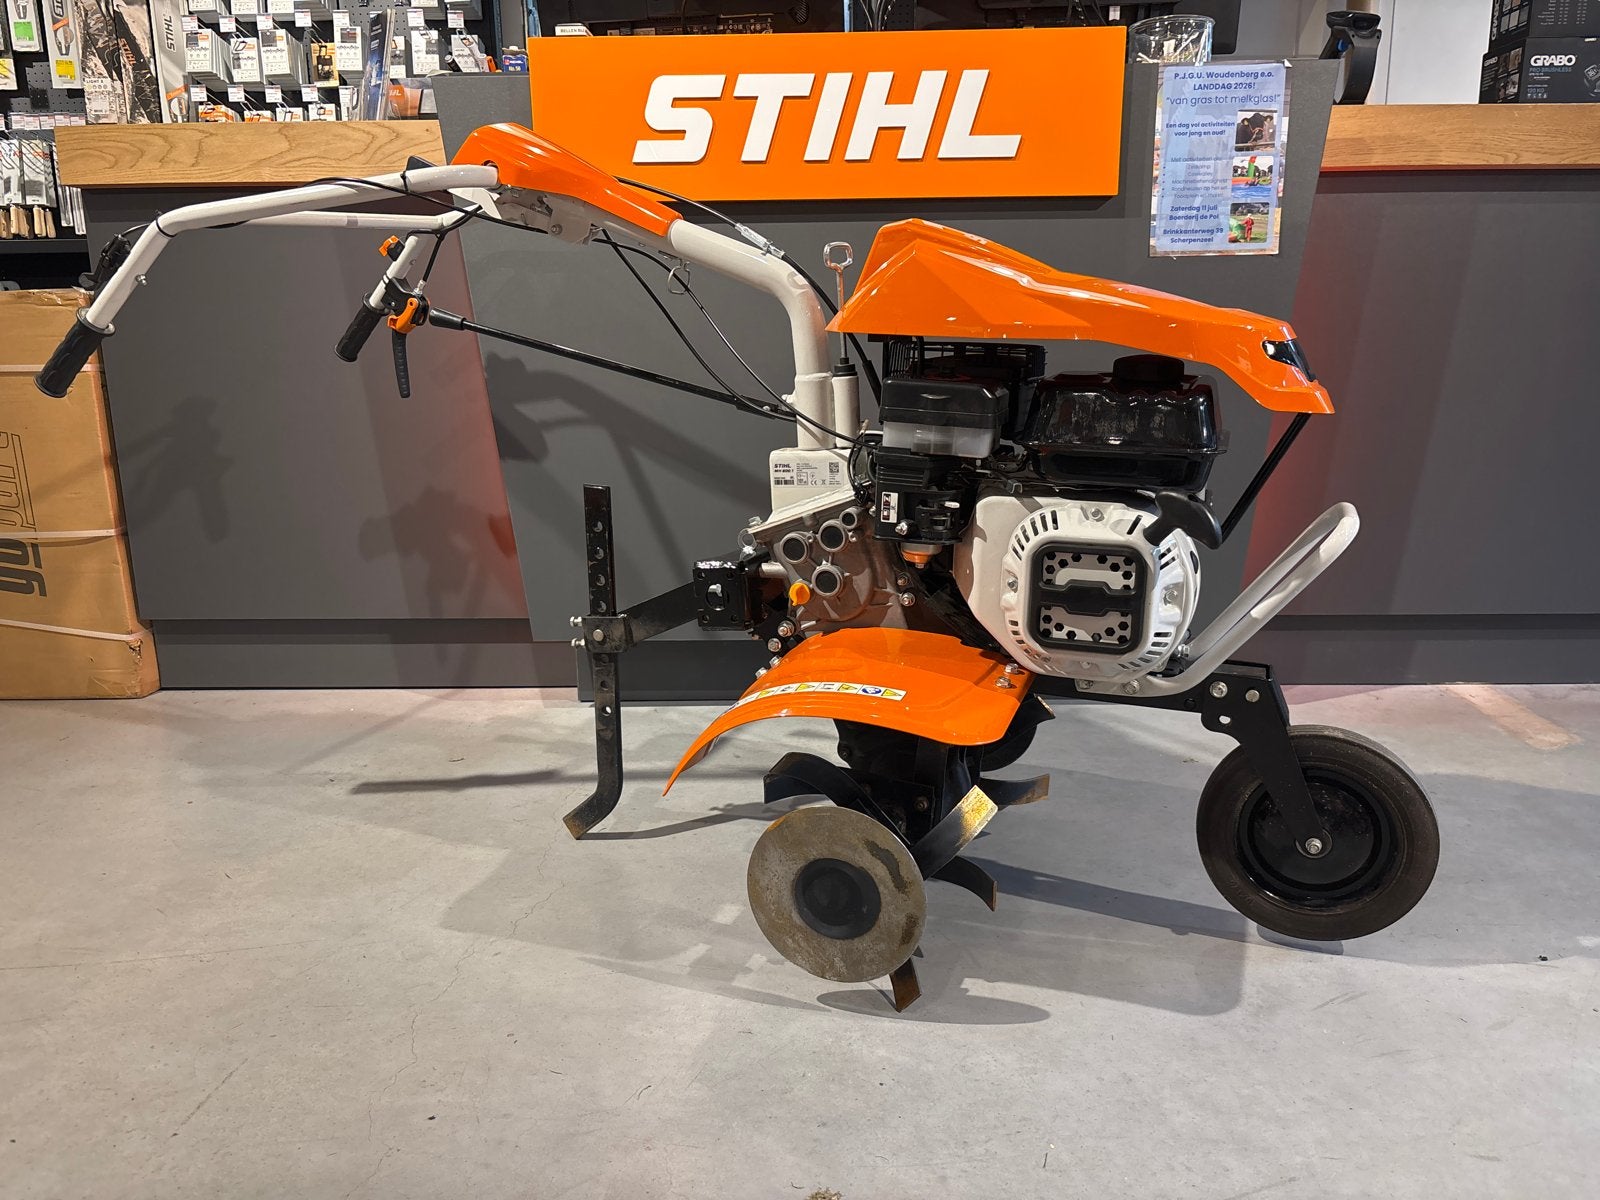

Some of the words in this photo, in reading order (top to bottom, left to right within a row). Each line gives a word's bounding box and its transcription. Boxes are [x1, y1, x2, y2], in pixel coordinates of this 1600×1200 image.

[164, 15, 176, 51] STIHL
[119, 38, 137, 65] STIHL
[1530, 54, 1576, 66] GRABO
[1174, 72, 1204, 80] P.J.G.U.
[1206, 71, 1259, 80] Woudenberg
[1193, 82, 1232, 91] LANDDAG
[1233, 82, 1256, 90] 2026!
[1190, 96, 1213, 107] gras
[1214, 95, 1228, 104] tot
[632, 69, 1022, 163] STIHL
[1178, 122, 1190, 130] dag
[1188, 130, 1202, 138] jong
